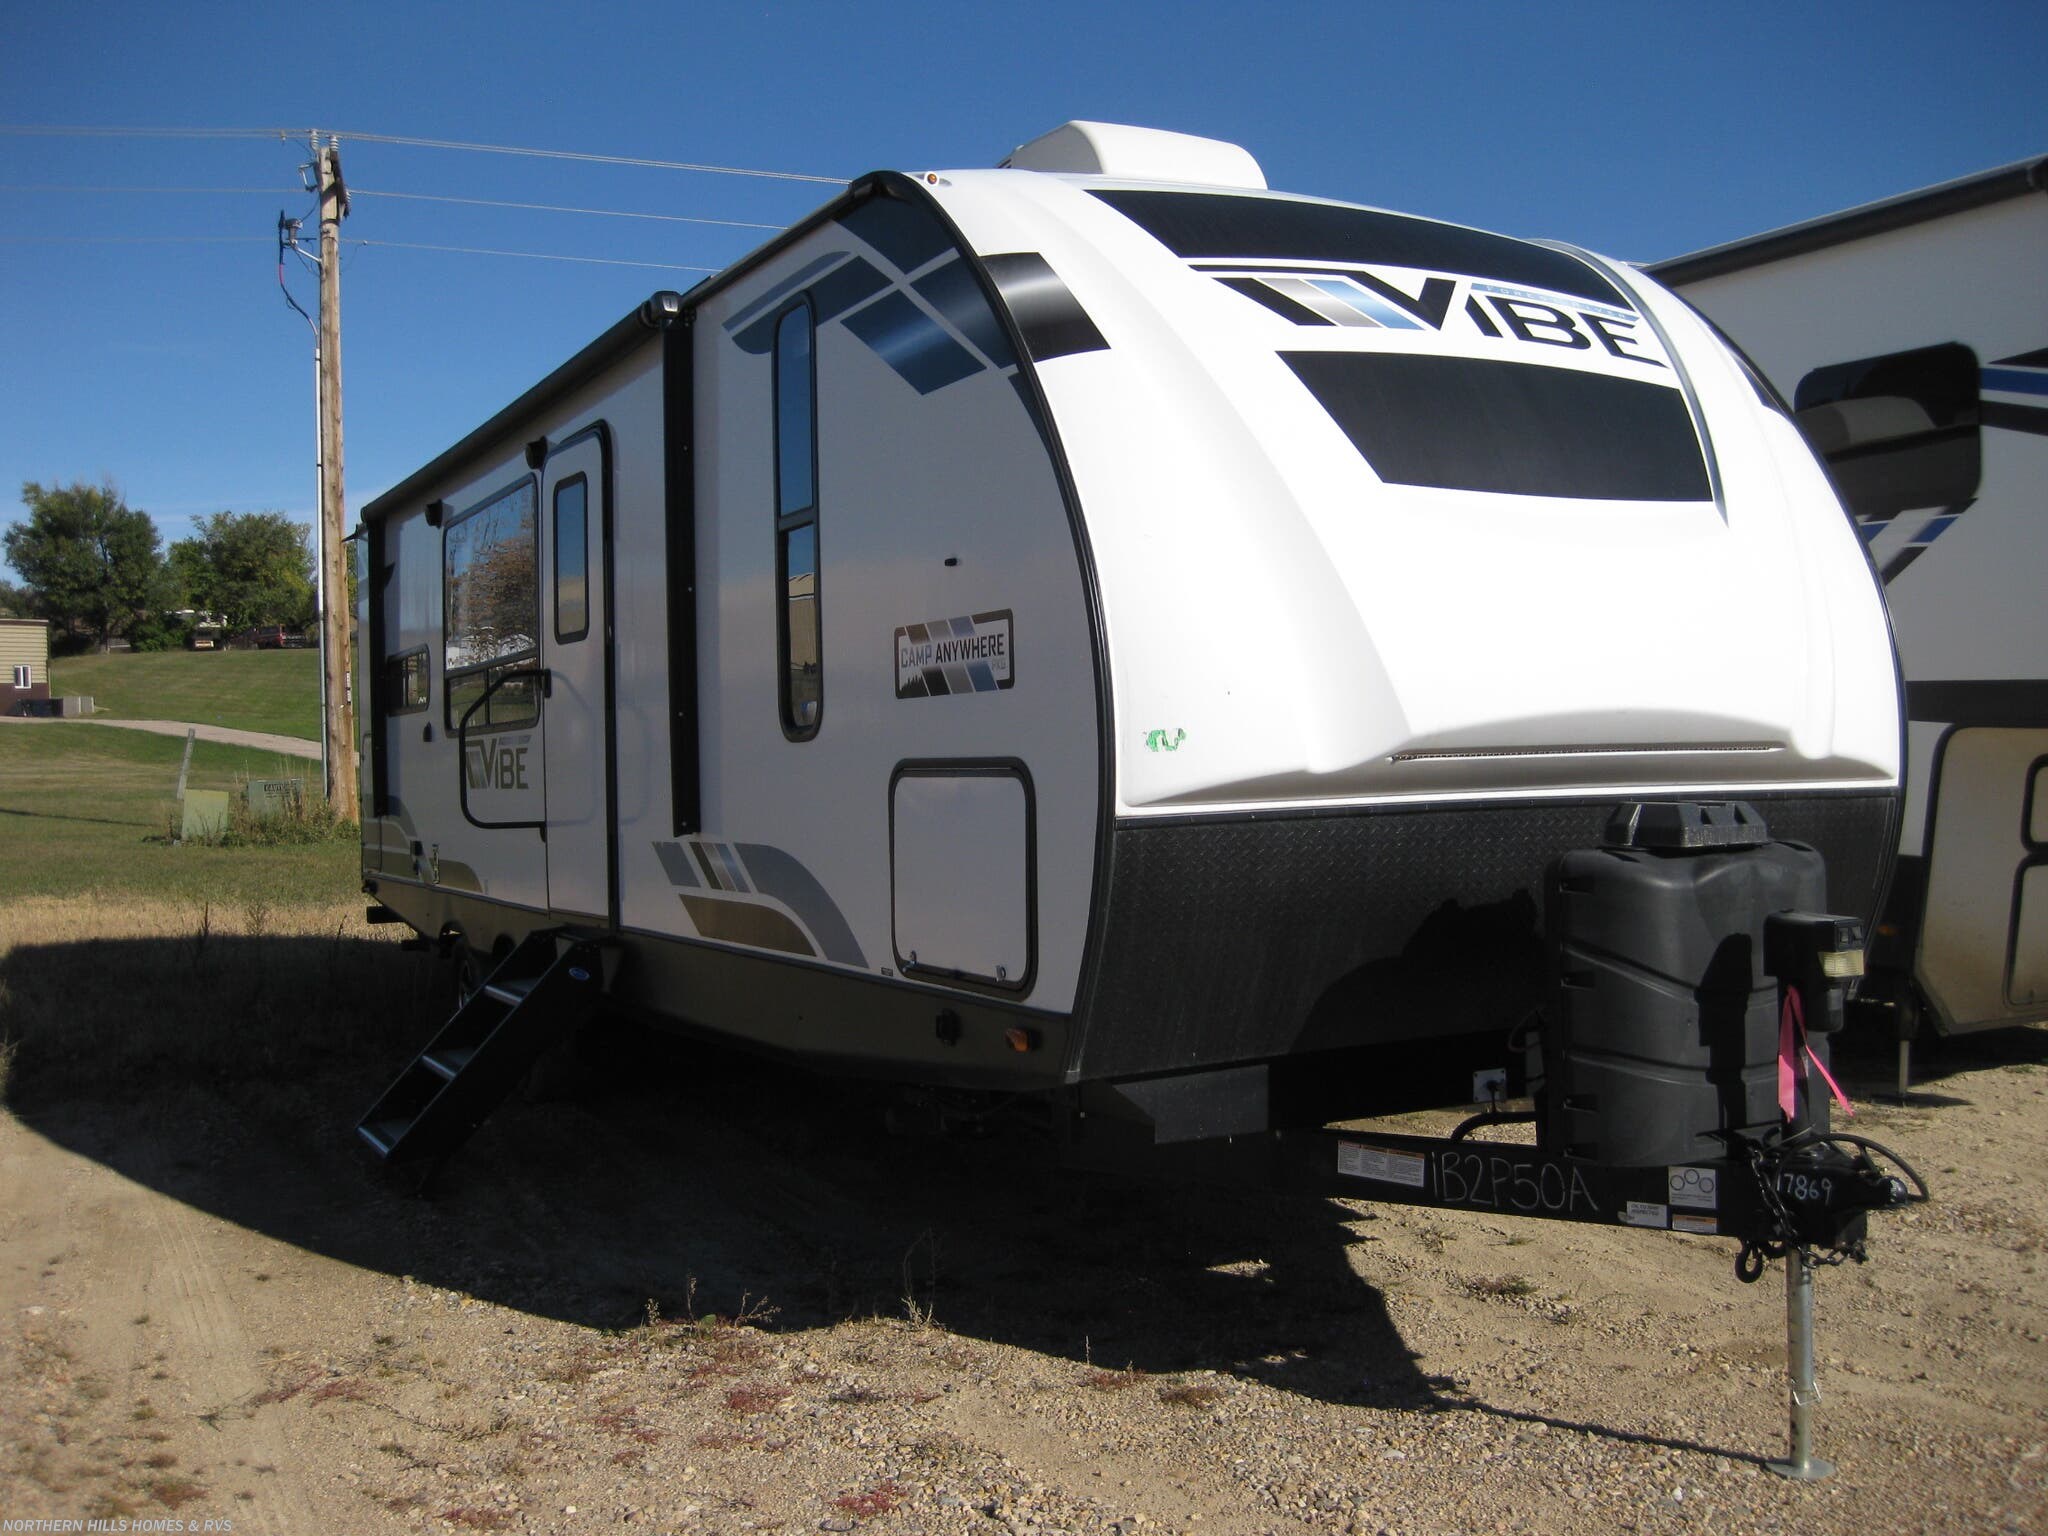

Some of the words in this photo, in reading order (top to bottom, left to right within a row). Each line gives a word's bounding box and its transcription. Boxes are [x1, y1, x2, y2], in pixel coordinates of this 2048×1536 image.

[1343, 270, 1670, 368] VIBE
[901, 643, 933, 669] CAMP
[935, 633, 1005, 664] ANYWHERE
[479, 737, 530, 790] VIBE
